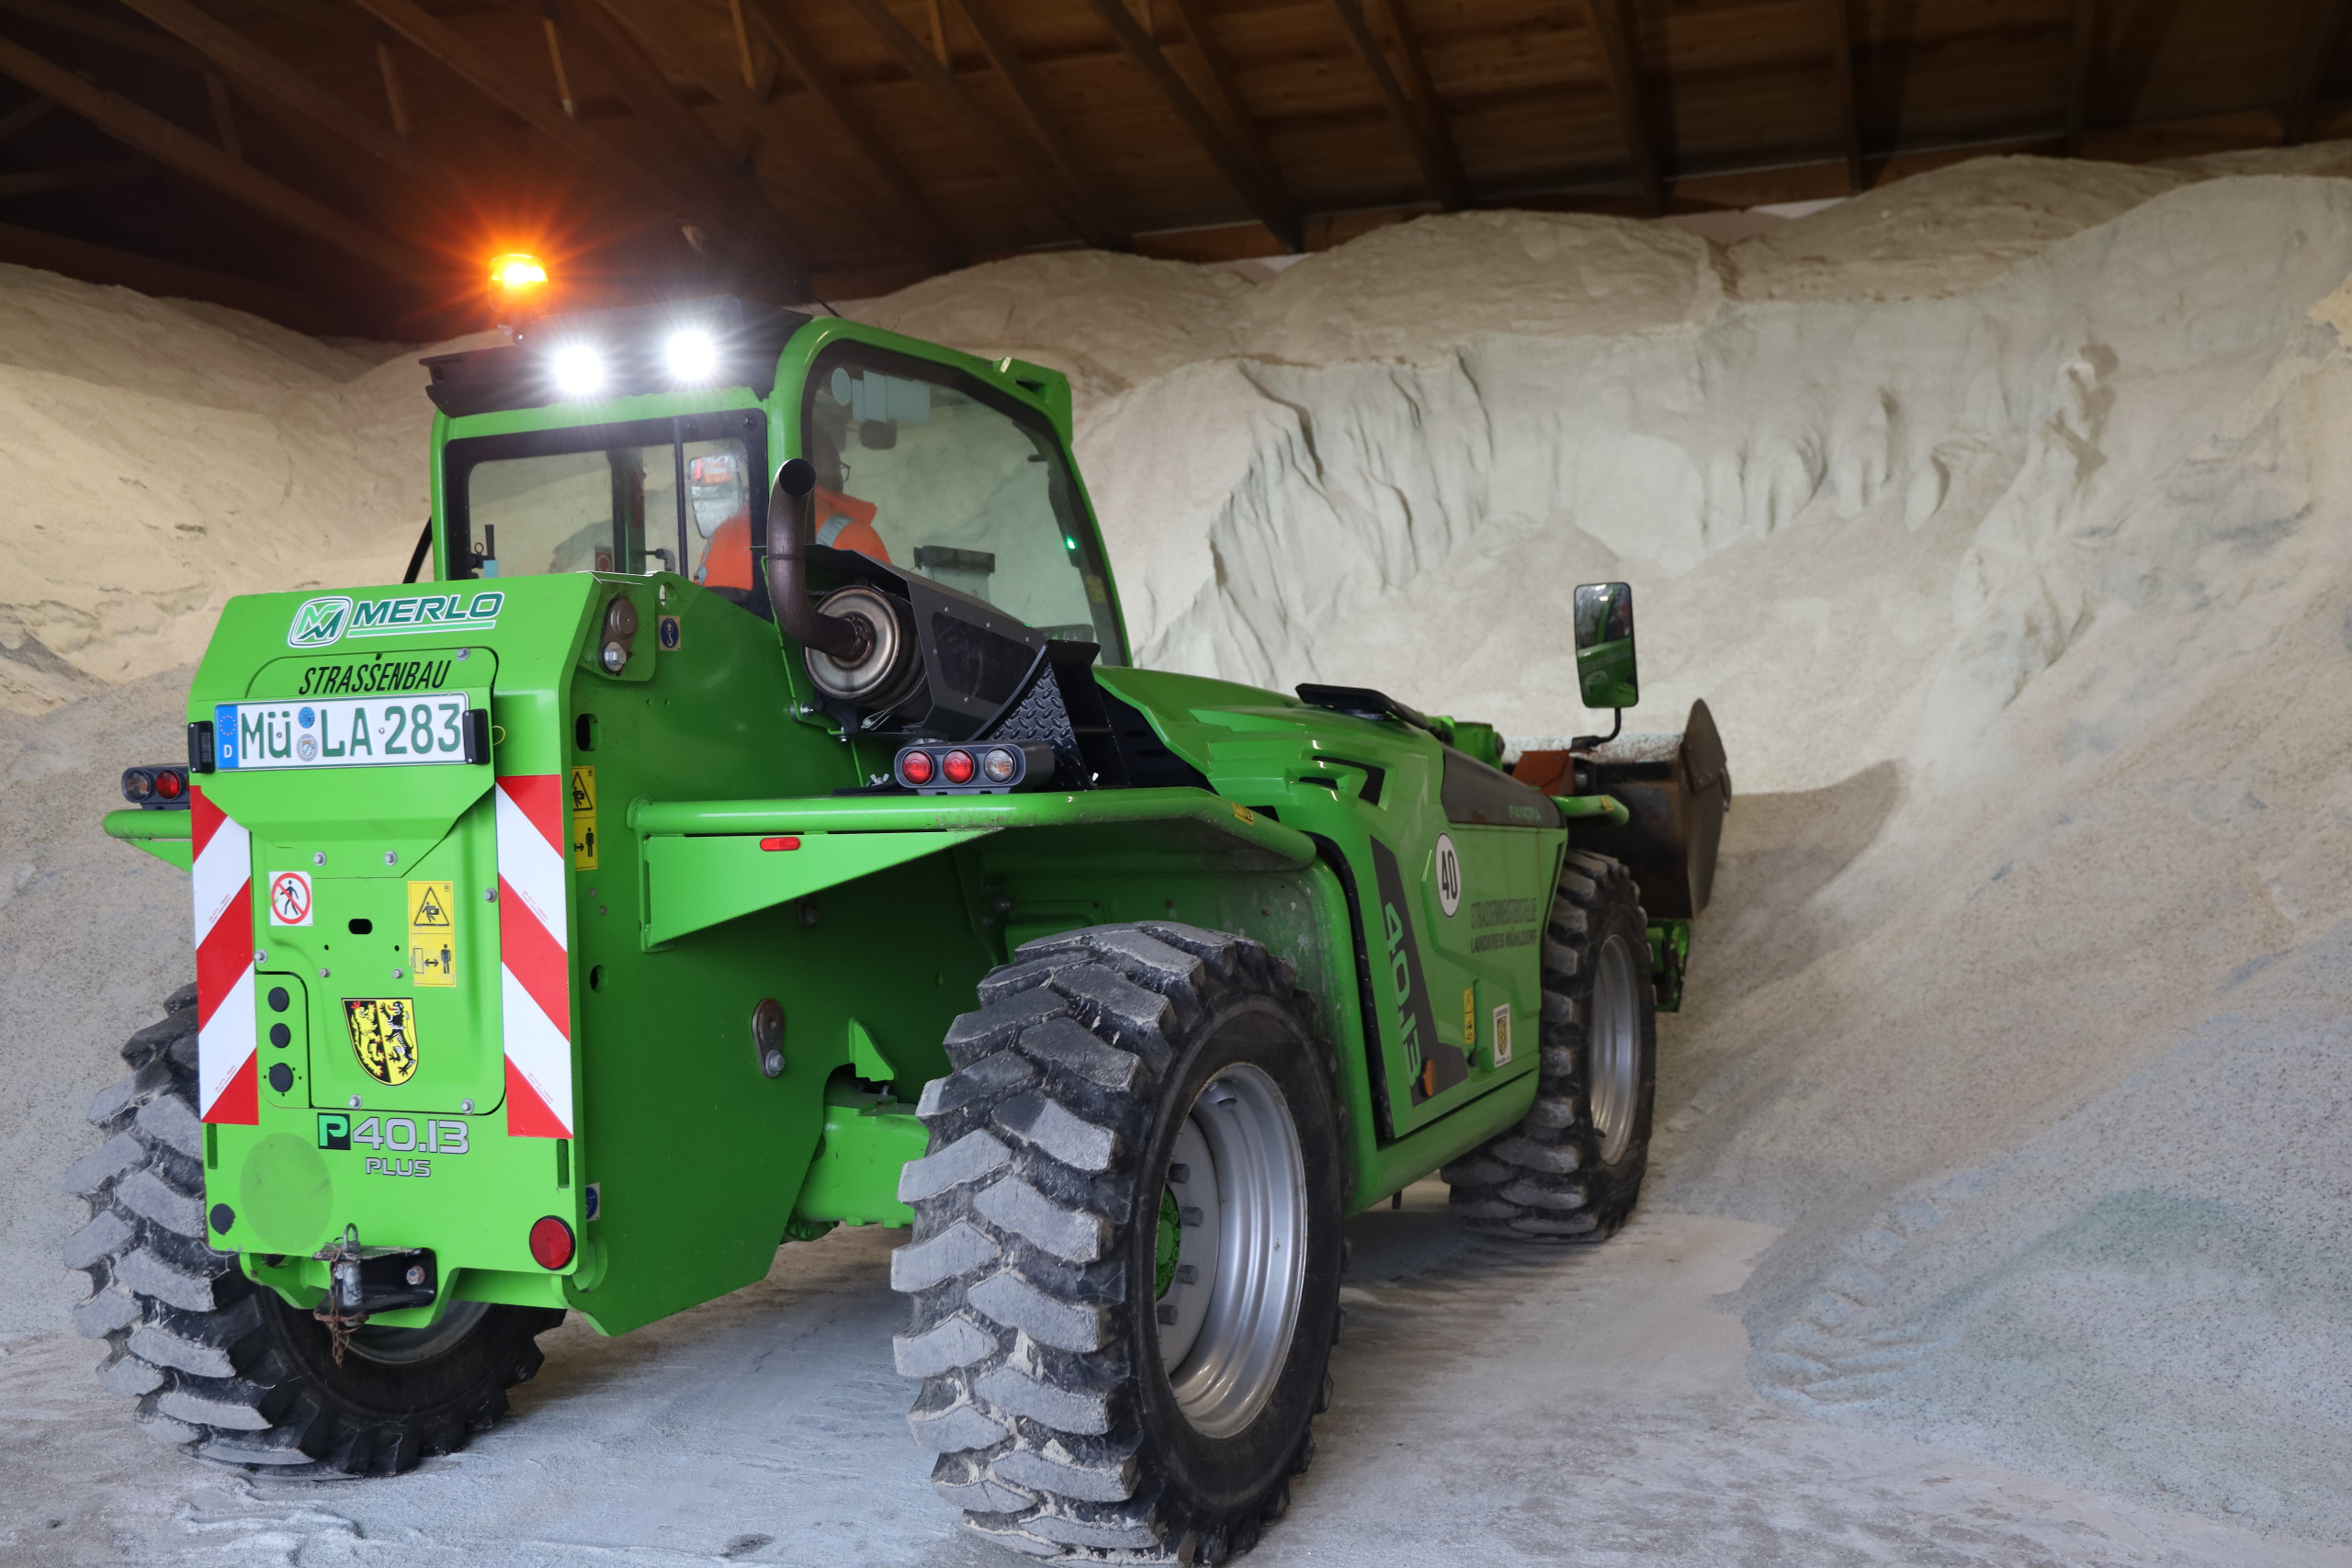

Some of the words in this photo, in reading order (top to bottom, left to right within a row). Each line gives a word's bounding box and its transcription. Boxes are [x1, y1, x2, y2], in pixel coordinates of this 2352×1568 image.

[353, 592, 504, 627] MERLO
[299, 661, 452, 695] STRASSENBAU
[321, 707, 373, 758] LA
[384, 703, 461, 755] 283
[223, 744, 232, 758] D
[1441, 850, 1459, 901] 40
[366, 1156, 431, 1178] PLUS
